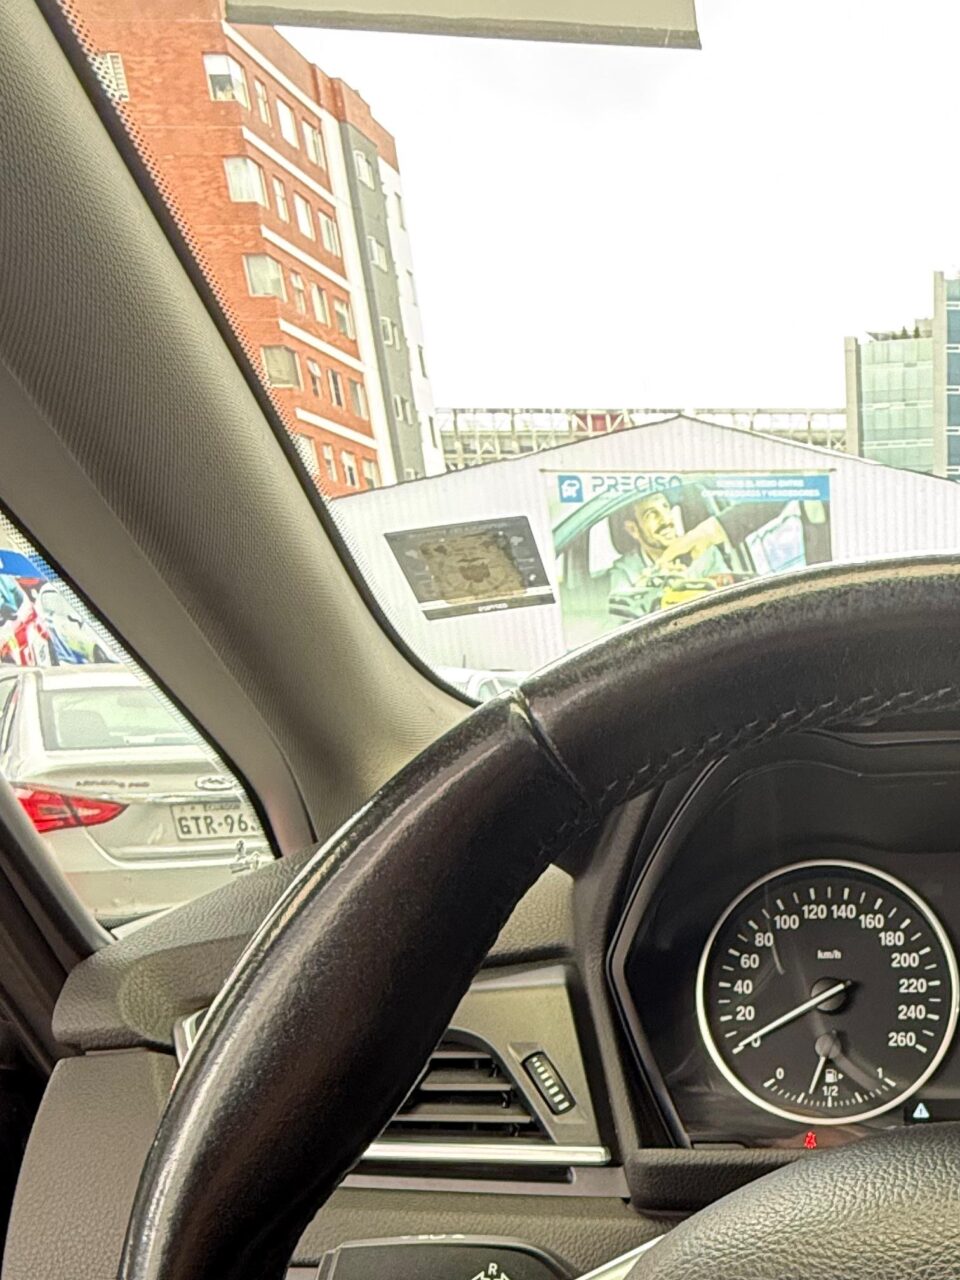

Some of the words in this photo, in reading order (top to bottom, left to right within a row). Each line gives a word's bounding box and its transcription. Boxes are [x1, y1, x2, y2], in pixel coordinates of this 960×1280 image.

[592, 475, 684, 492] PRECISO
[178, 814, 256, 835] GTR-96
[802, 905, 827, 919] 120
[831, 904, 856, 919] 140
[774, 915, 799, 930] 100
[859, 914, 884, 929] 160
[755, 933, 774, 947] 80
[879, 932, 904, 946] 180
[741, 954, 759, 968] 60
[817, 950, 841, 960] km/h
[891, 953, 919, 967] 200
[734, 980, 752, 994] 40
[899, 979, 927, 993] 220
[736, 1006, 755, 1021] 20
[898, 1005, 925, 1019] 240
[888, 1032, 916, 1046] 260
[776, 1068, 784, 1079] 0
[877, 1068, 883, 1078] 1
[822, 1086, 839, 1096] 1/2
[488, 1263, 497, 1275] R
